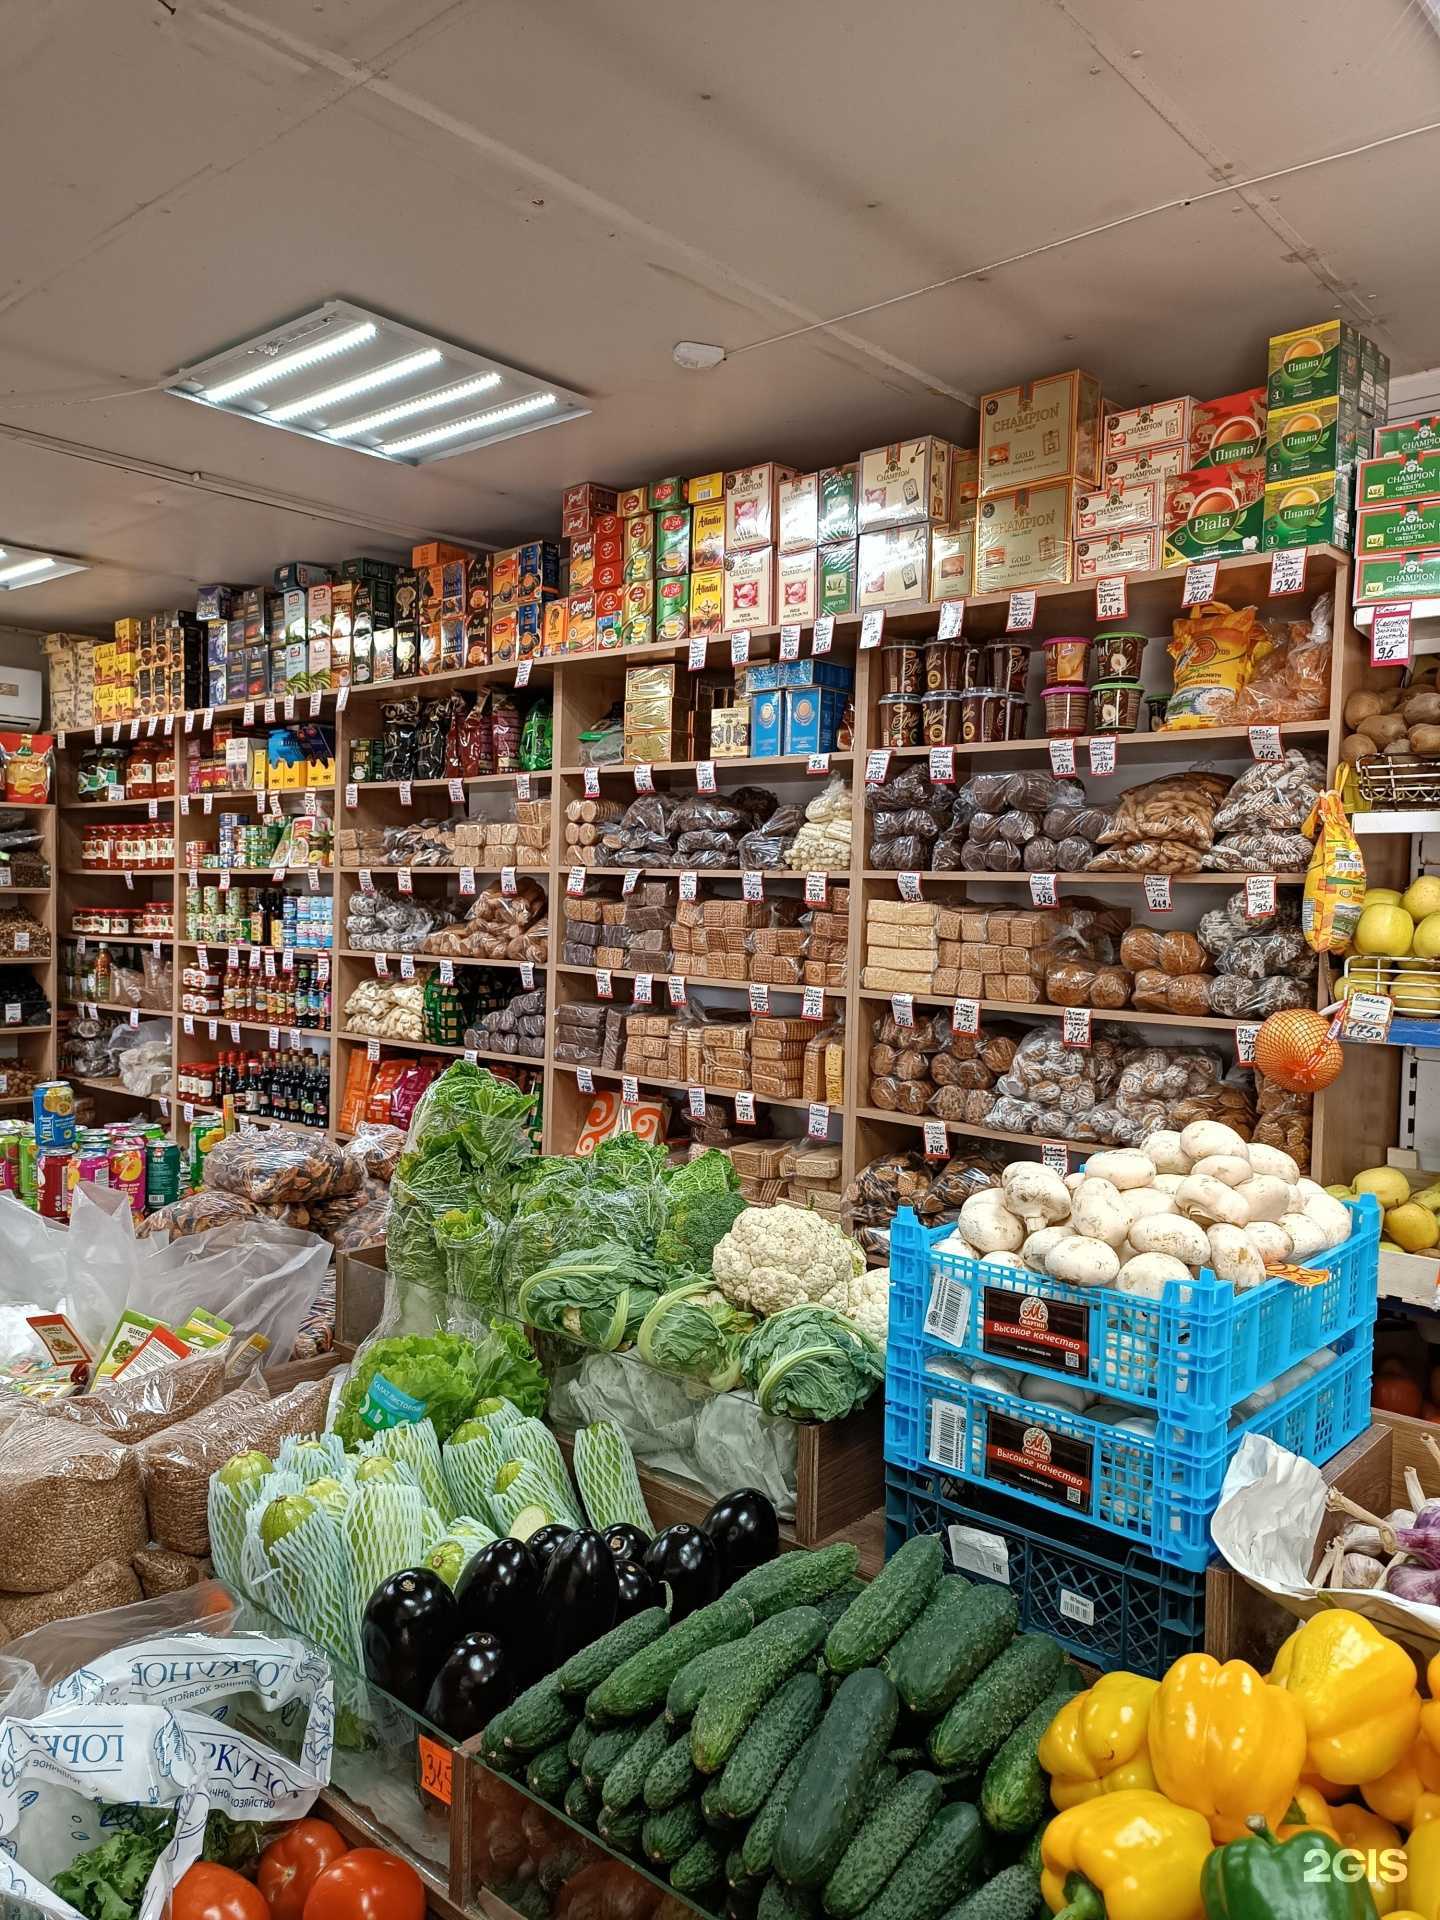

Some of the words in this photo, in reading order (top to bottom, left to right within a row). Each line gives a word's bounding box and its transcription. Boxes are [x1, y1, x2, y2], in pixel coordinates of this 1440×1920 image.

[1288, 359, 1319, 373] Пиала
[992, 405, 1060, 433] CHAMPION
[1126, 421, 1162, 436] CHAMPION
[1287, 433, 1317, 447] Пиала
[1402, 437, 1440, 450] CHAMPIO
[1216, 445, 1254, 462] Пиала
[1124, 466, 1161, 480] CHAMPION
[1387, 470, 1435, 484] CHAMPION
[1284, 509, 1315, 520] Пиала
[1194, 515, 1230, 533] Piala
[1387, 520, 1435, 533] CHAMPION
[1011, 555, 1030, 564] GOLD
[1387, 572, 1435, 583] CHAMPION
[128, 1327, 149, 1339] SIRE
[994, 1322, 1031, 1337] Высокое
[1033, 1332, 1080, 1350] качество
[997, 1447, 1034, 1467] Высокое
[1036, 1462, 1083, 1486] качество
